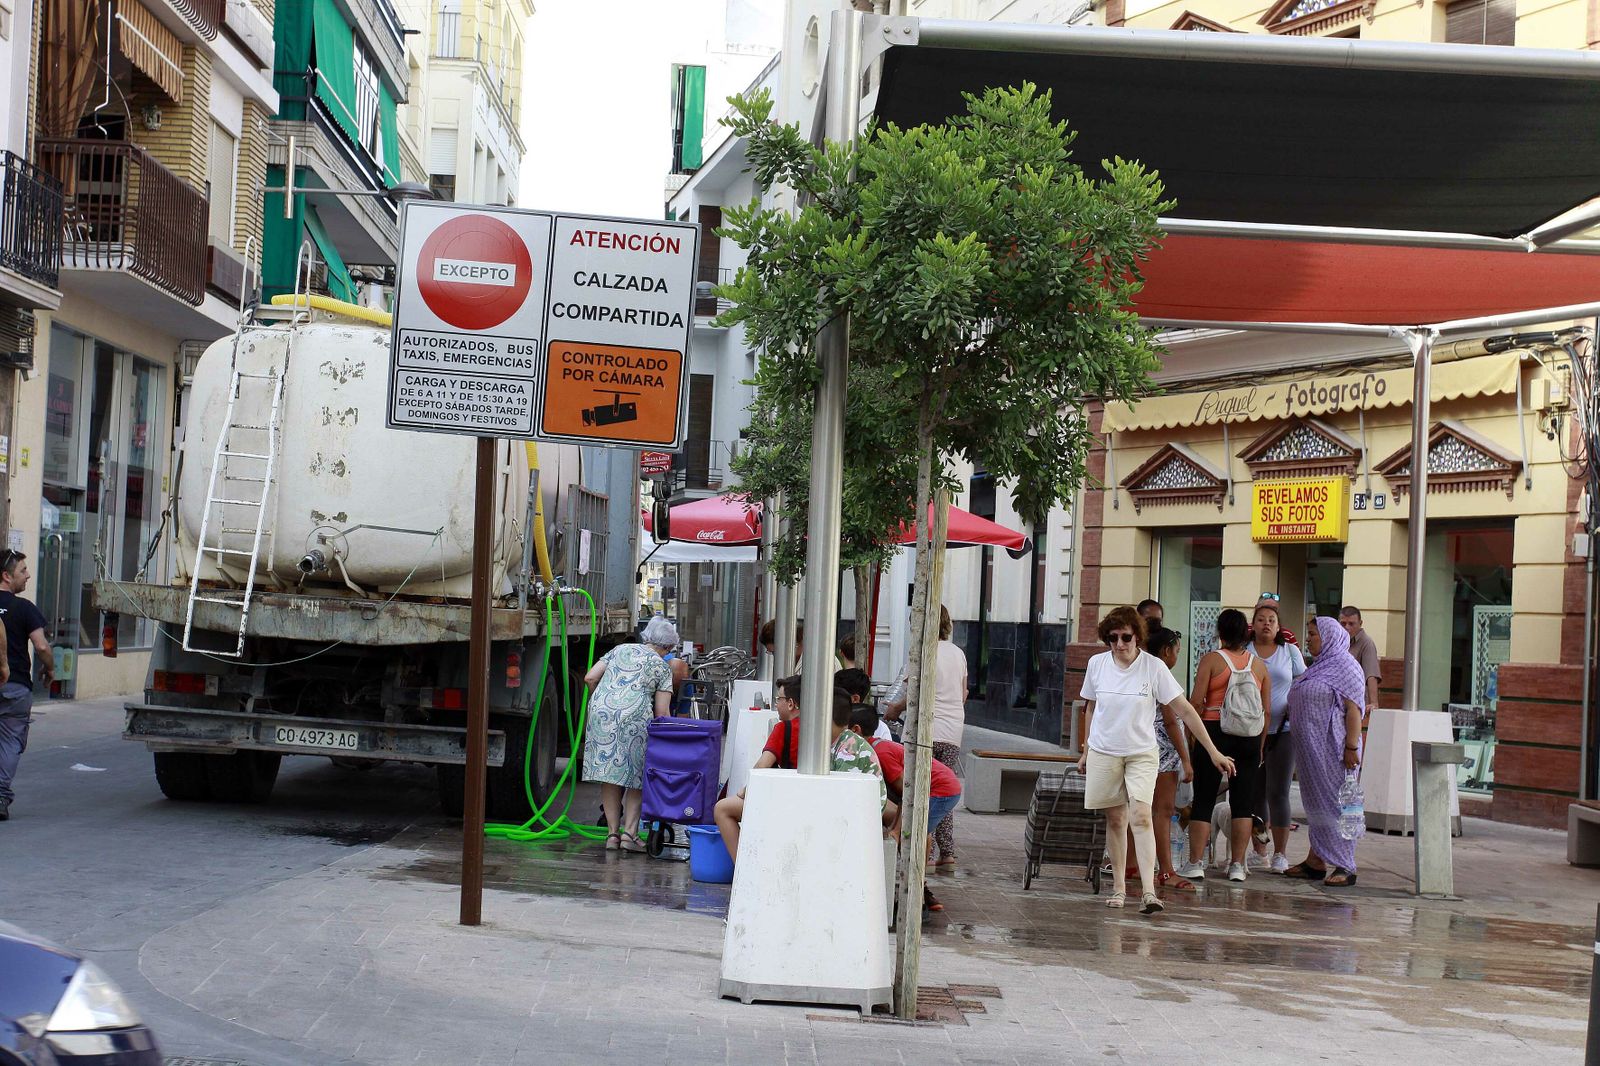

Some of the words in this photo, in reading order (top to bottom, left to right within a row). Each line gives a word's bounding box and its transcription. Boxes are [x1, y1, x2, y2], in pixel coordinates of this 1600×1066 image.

[570, 229, 681, 254] ATENCIÓN
[440, 263, 509, 281] EXCEPTO
[573, 271, 668, 293] CALZADA
[552, 302, 684, 328] COMPARTIDA
[403, 335, 498, 353] AUTORIZADOS,
[507, 344, 533, 356] BUS
[403, 349, 440, 362] TAXIS,
[443, 352, 532, 369] EMERGENCIAS
[562, 351, 668, 371] CONTROLADO
[405, 376, 447, 388] CARGA
[450, 379, 458, 389] Y
[460, 380, 525, 394] DESCARGA
[562, 368, 594, 382] POR
[598, 370, 665, 388] CÁMARA
[400, 388, 414, 396] DE
[417, 389, 424, 397] 6
[425, 390, 433, 398] A
[436, 391, 447, 399] 11
[449, 392, 457, 400] Y
[459, 392, 474, 401] DE
[477, 394, 504, 404] 15:30
[505, 396, 513, 405] A
[516, 397, 528, 406] 19
[398, 398, 443, 410] EXCEPTO
[445, 401, 492, 414] SÁBADOS
[494, 406, 529, 418] TARDE,
[408, 409, 460, 422] DOMINGOS
[462, 413, 470, 422] Y
[470, 414, 518, 427] FESTIVOS
[1259, 486, 1329, 505] REVELAMOS
[1261, 506, 1284, 523] SUS
[1288, 504, 1325, 522] FOTOS
[1269, 526, 1279, 534] AL
[1280, 524, 1316, 534] INSTANTE
